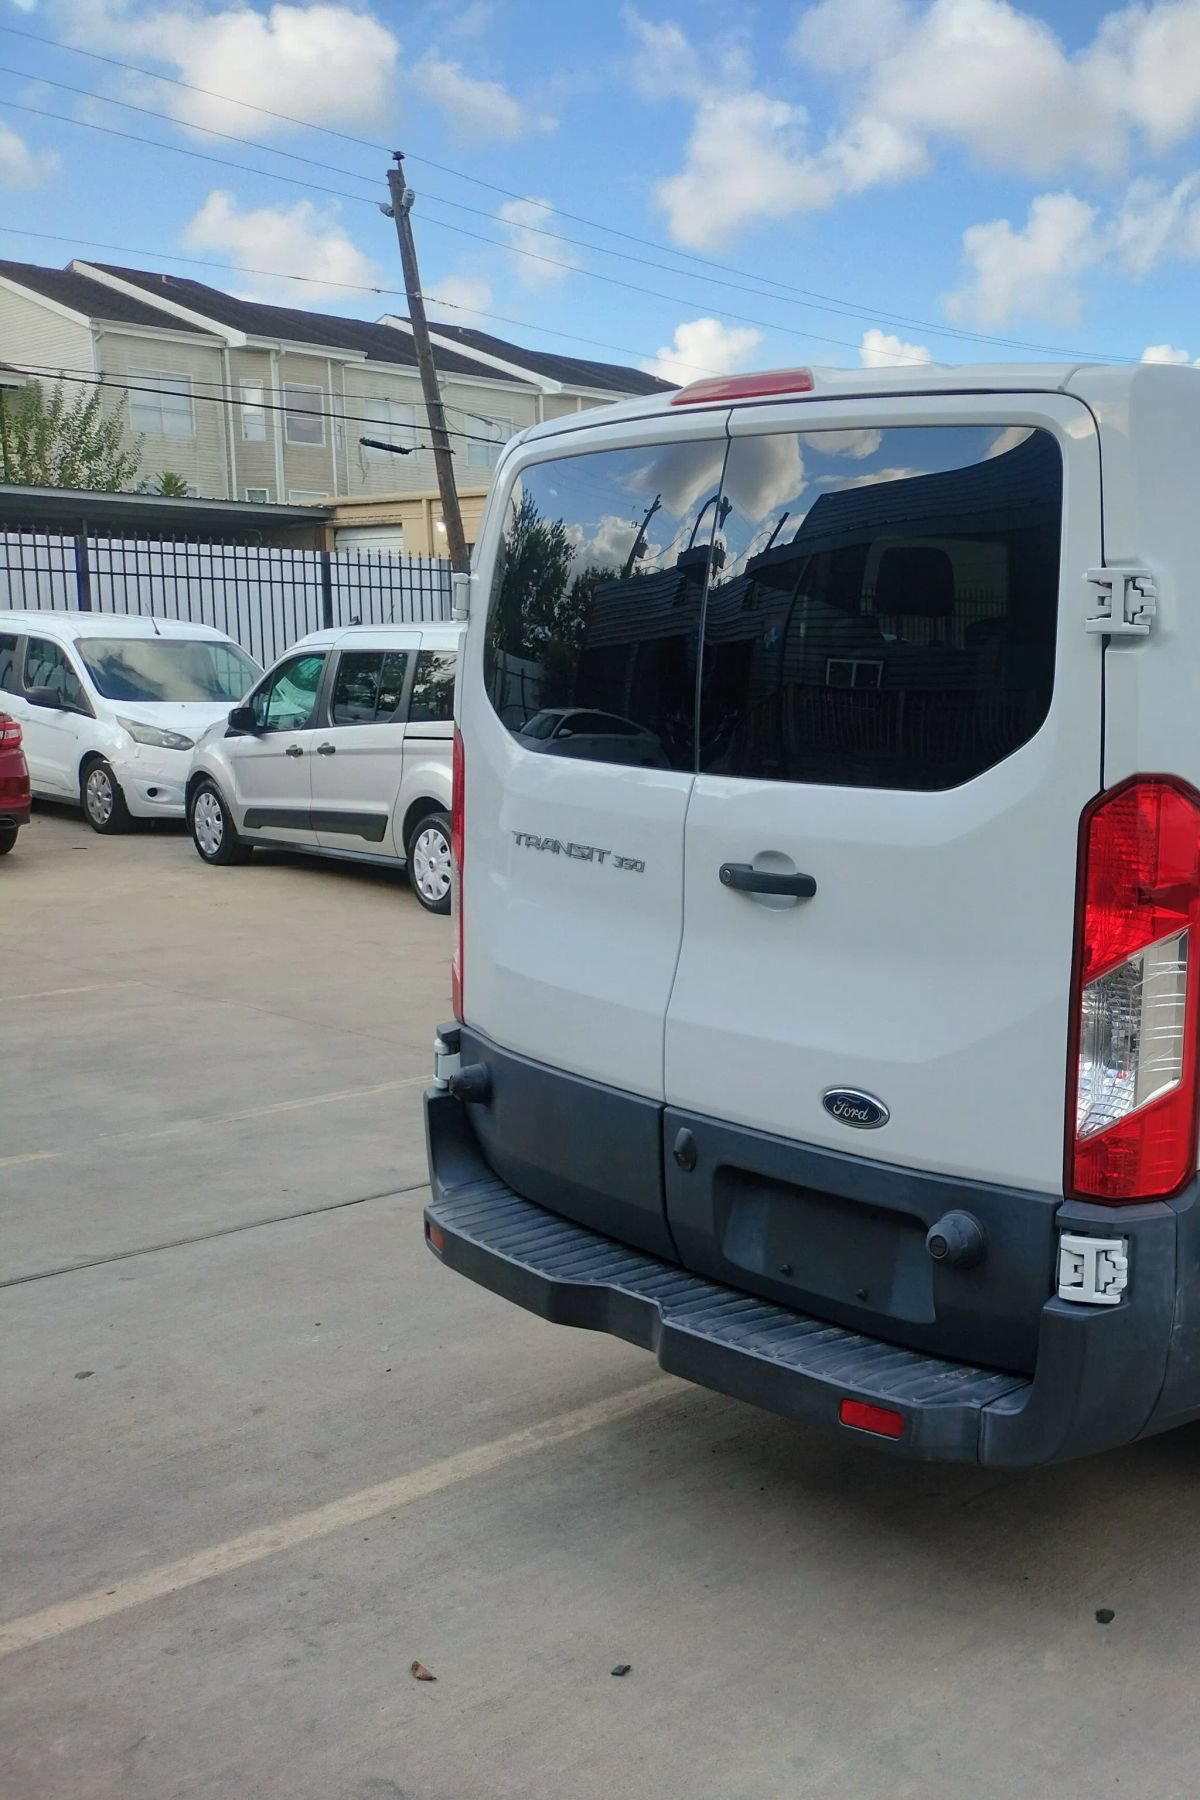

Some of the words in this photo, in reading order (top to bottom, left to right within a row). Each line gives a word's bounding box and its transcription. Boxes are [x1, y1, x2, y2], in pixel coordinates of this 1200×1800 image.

[512, 830, 611, 864] TRANSIT
[612, 854, 646, 873] 350
[833, 1096, 869, 1121] Ford
